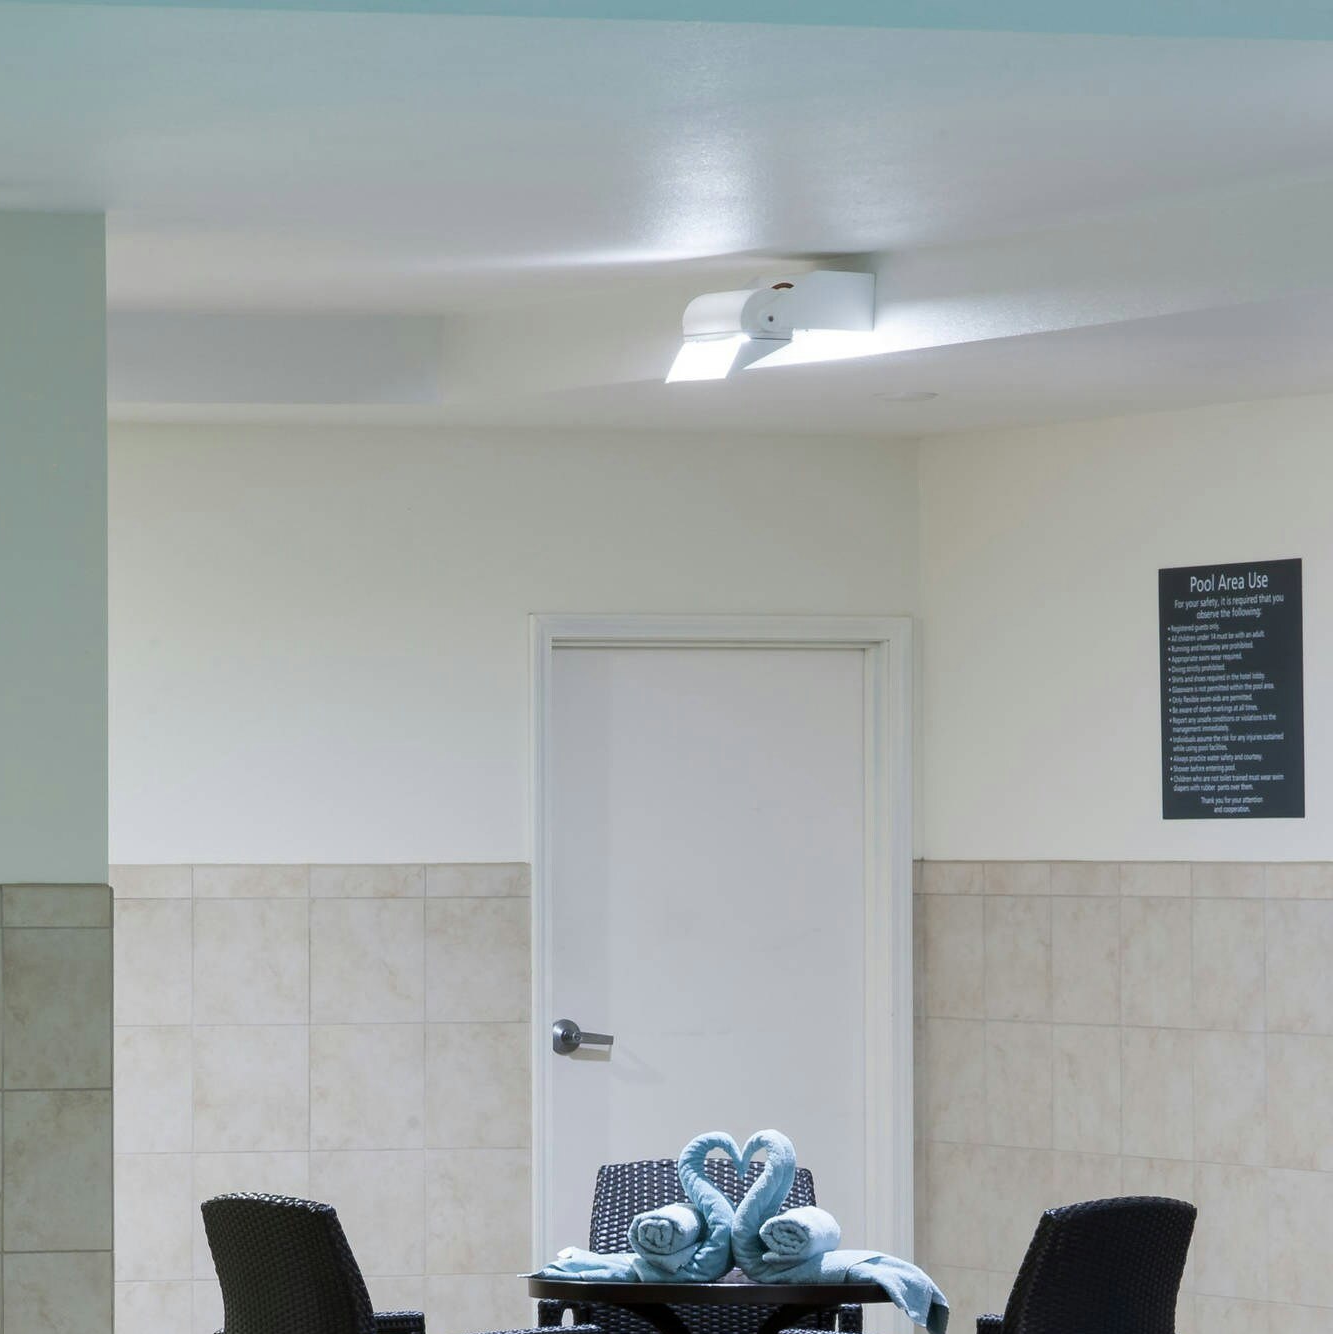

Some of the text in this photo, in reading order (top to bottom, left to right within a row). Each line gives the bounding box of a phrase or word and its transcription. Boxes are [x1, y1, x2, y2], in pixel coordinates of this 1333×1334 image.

[1190, 571, 1269, 592] Pool Area Use
[1174, 599, 1184, 609] For
[1272, 594, 1284, 606] you
